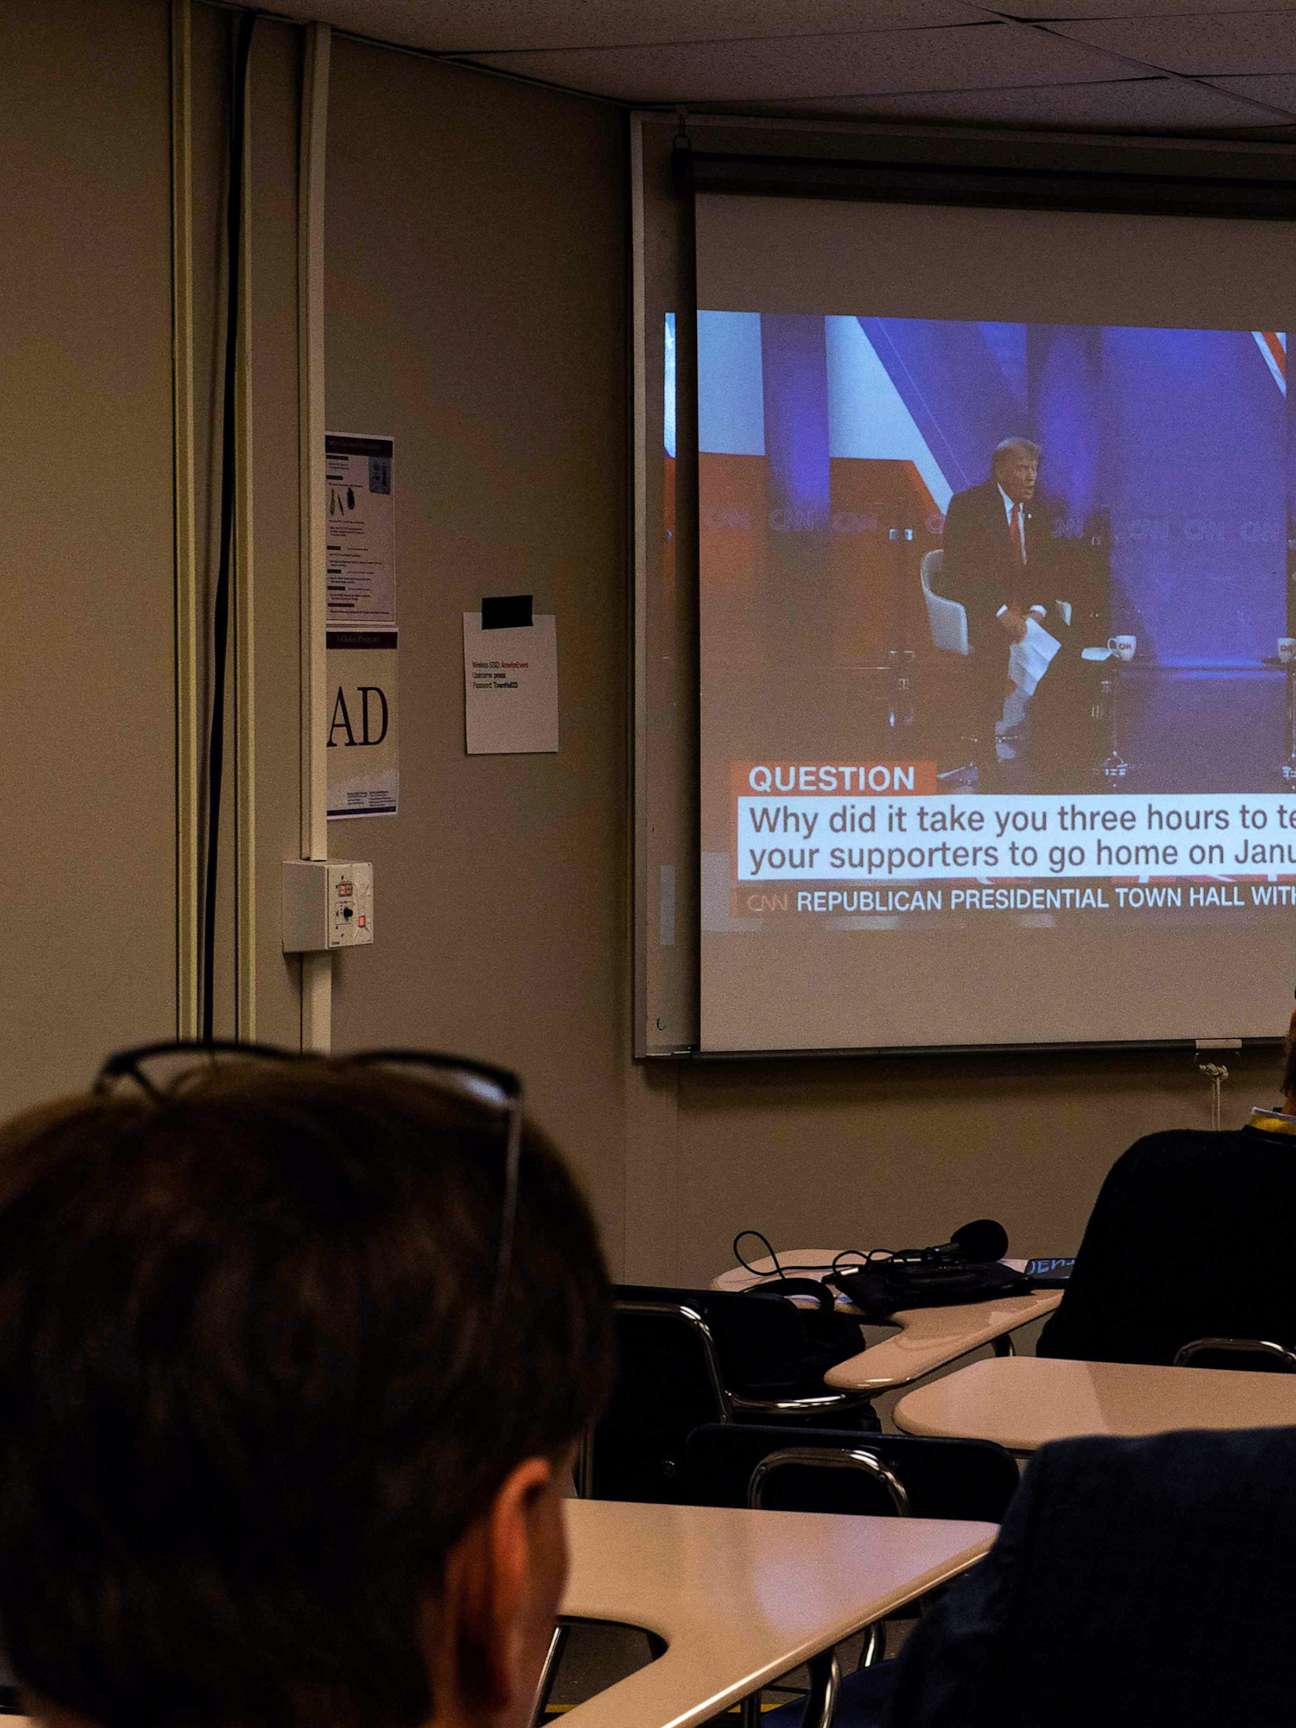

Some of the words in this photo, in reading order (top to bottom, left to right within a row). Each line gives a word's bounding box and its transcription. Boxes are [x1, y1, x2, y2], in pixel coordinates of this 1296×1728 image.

[748, 765, 915, 792] QUESTION
[749, 806, 819, 839] Why
[829, 805, 876, 833] did
[888, 805, 907, 832] it
[917, 805, 985, 832] take
[995, 811, 1047, 838] you
[1057, 804, 1136, 831] three
[1148, 804, 1230, 831] hours
[1240, 805, 1268, 829] to
[749, 848, 820, 875] your
[830, 842, 999, 874] supporters
[1008, 842, 1038, 867] to
[1049, 846, 1085, 873] go
[1097, 840, 1178, 866] home
[1189, 844, 1224, 865] on
[747, 893, 788, 912] CNN
[797, 890, 943, 912] REPUBLICAN
[950, 888, 1110, 910] PRESIDENTIAL
[1115, 887, 1182, 908] TOWN
[1189, 886, 1246, 907] HALL
